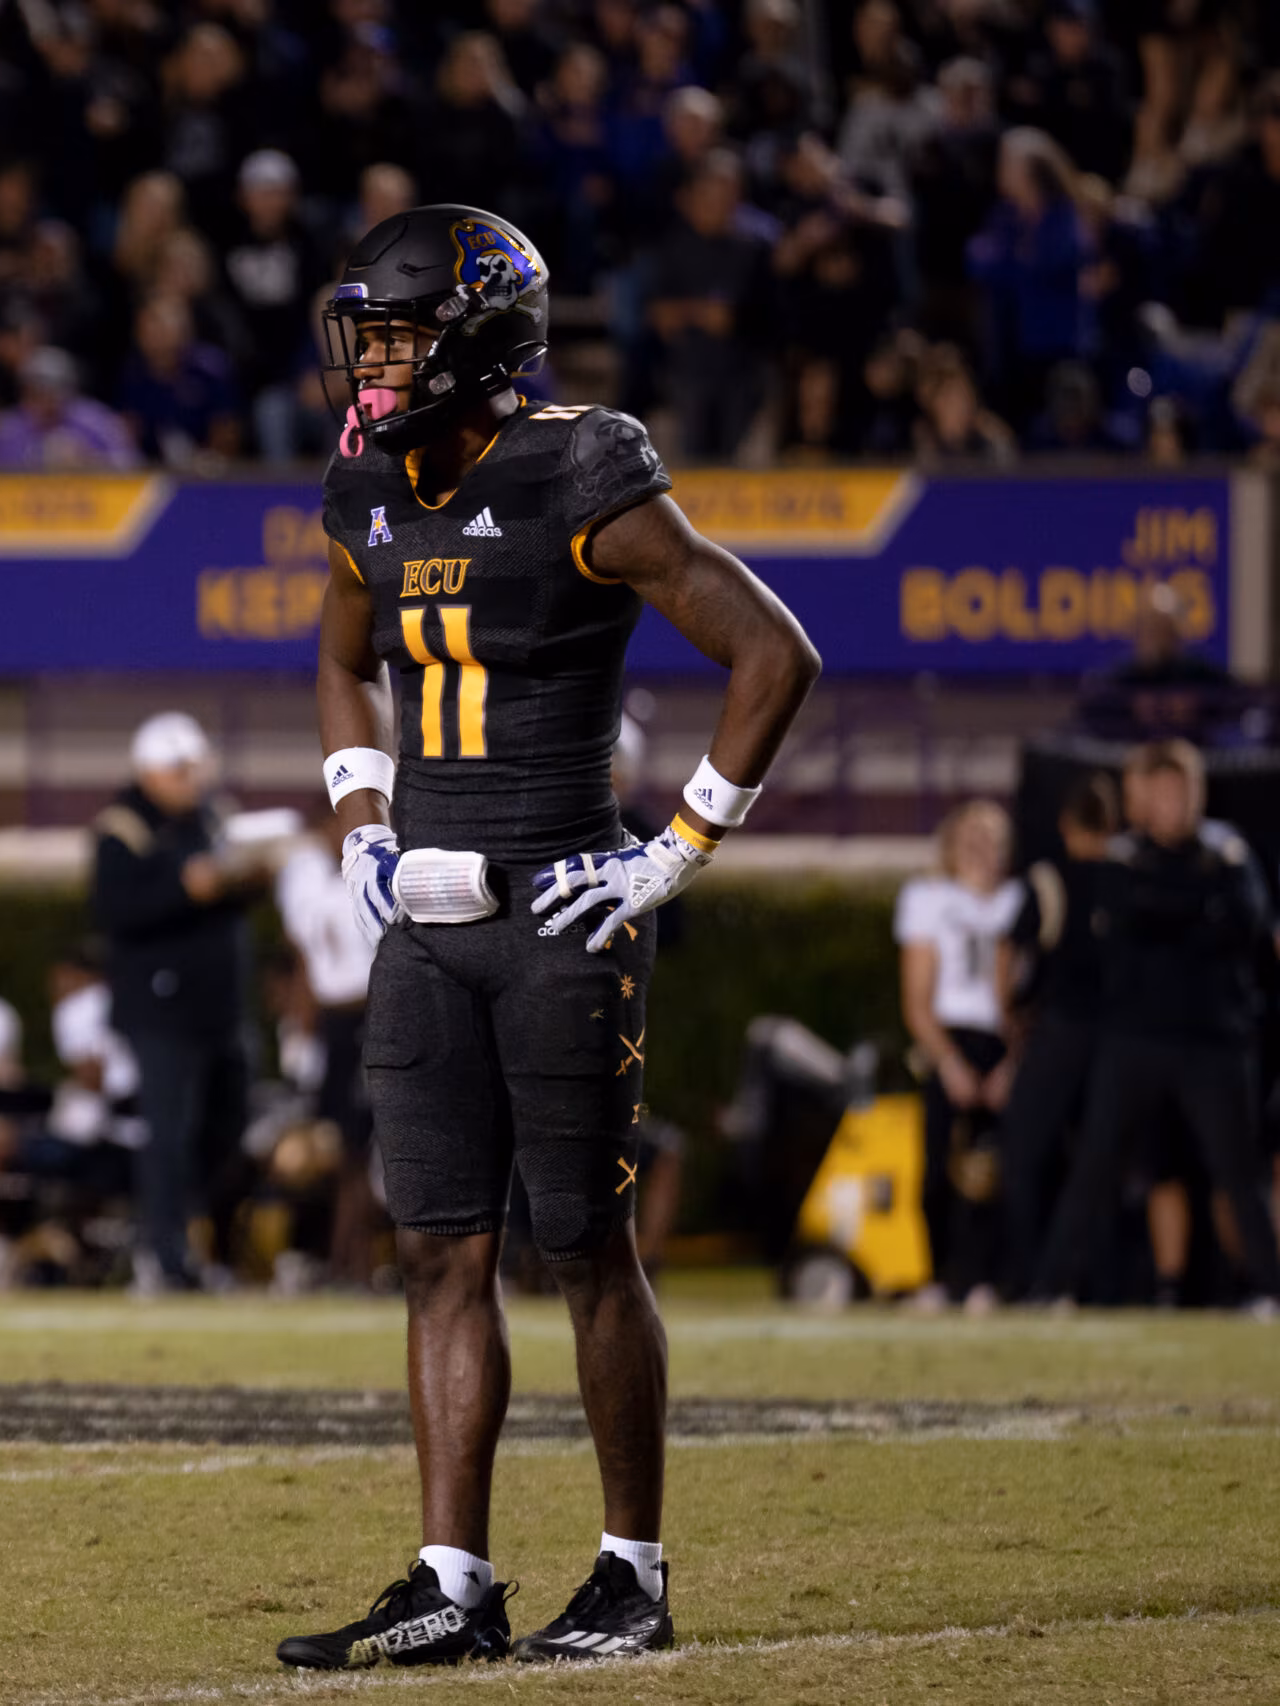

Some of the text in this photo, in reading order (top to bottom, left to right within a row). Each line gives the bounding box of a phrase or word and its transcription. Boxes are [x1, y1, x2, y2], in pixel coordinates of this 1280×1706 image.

[466, 232, 496, 250] ECU
[263, 508, 328, 561] DA
[462, 526, 502, 537] adidas
[1124, 508, 1215, 565] JIM
[400, 558, 472, 598] ECU
[197, 570, 324, 639] KEP
[398, 604, 489, 760] 11
[331, 772, 355, 788] adidas
[693, 788, 714, 810] adidas
[632, 876, 660, 906] adidas
